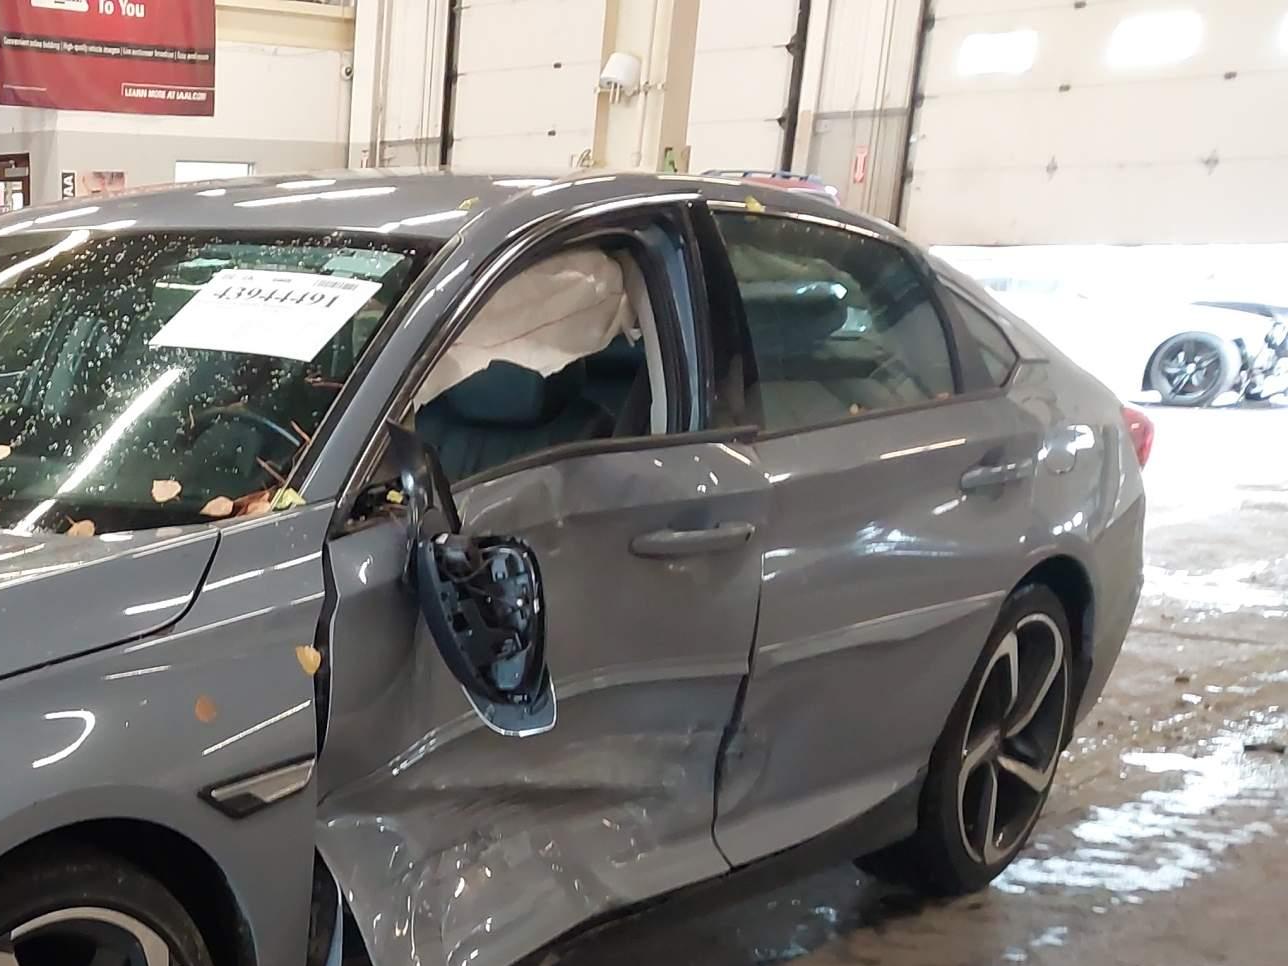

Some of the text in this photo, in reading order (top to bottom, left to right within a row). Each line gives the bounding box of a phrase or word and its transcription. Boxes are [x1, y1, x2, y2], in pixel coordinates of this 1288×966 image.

[98, 0, 146, 18] To You
[124, 87, 147, 98] LEARN
[148, 89, 166, 99] MORE
[166, 90, 176, 99] AT
[213, 286, 340, 308] 43944491
